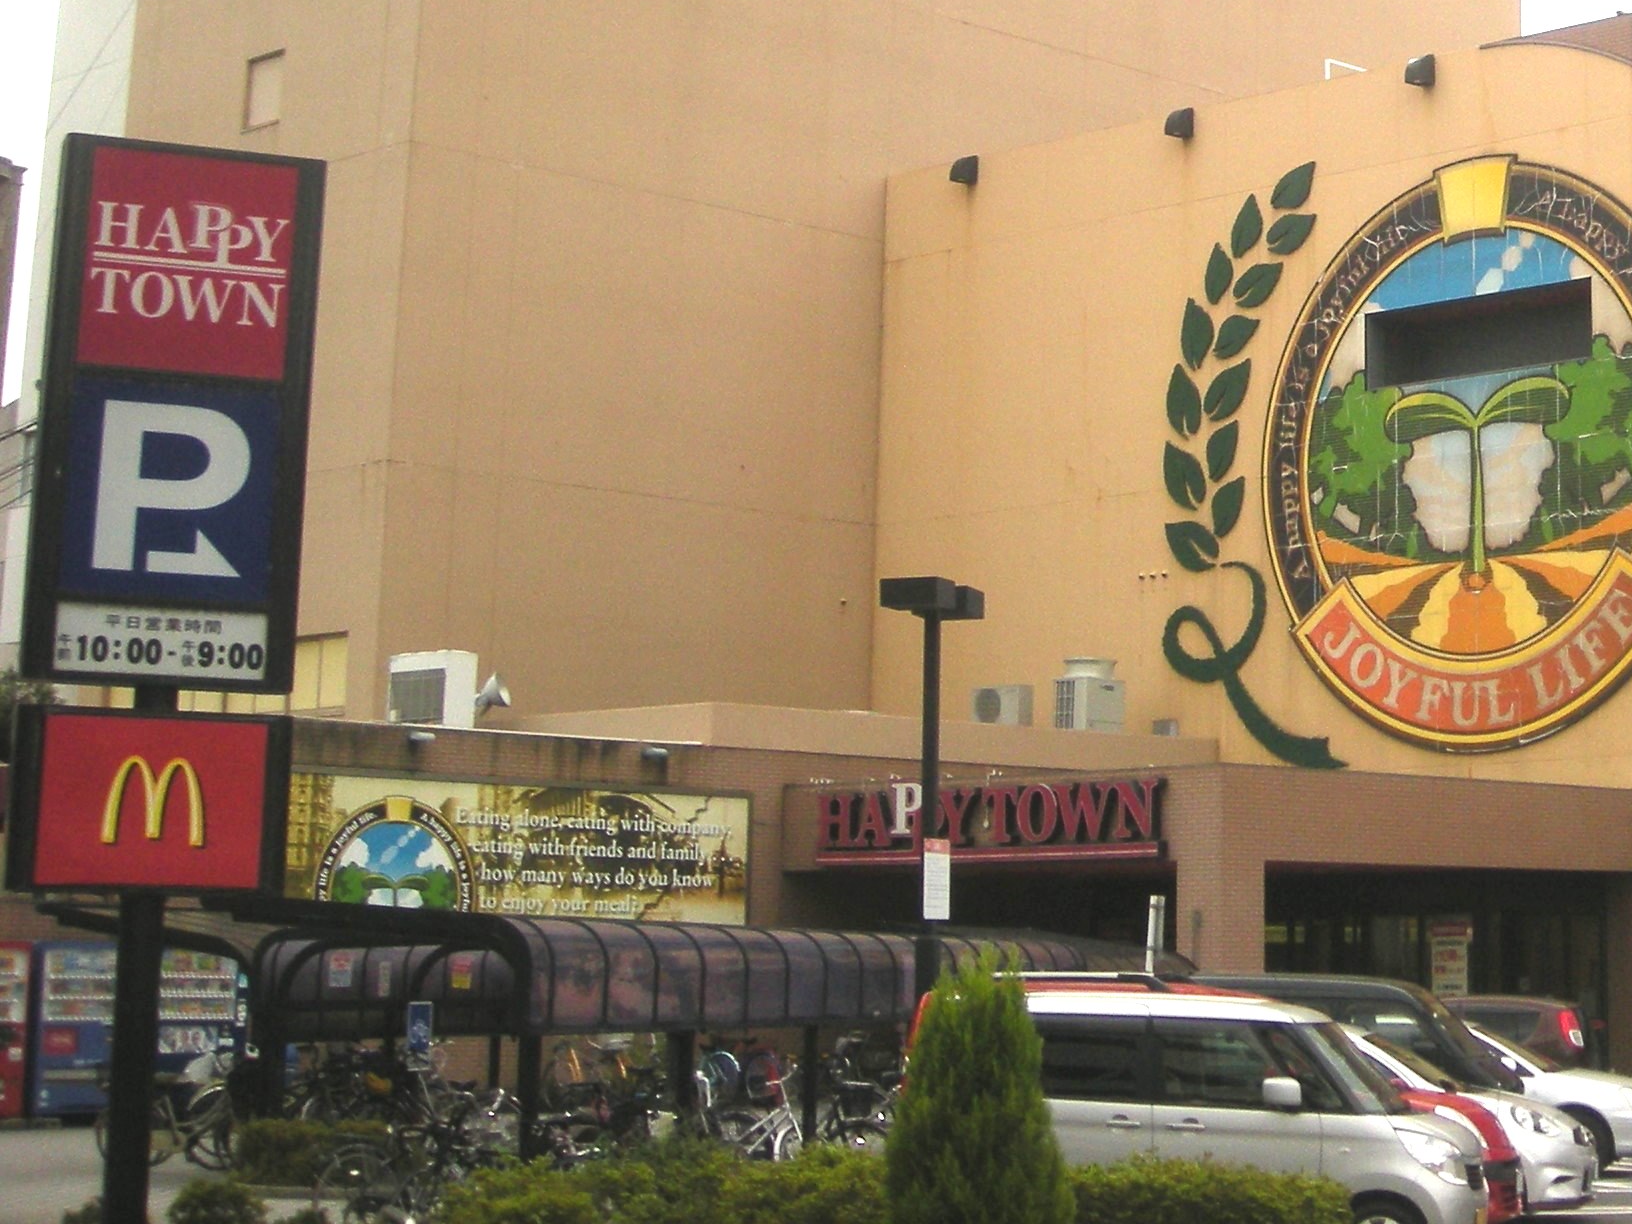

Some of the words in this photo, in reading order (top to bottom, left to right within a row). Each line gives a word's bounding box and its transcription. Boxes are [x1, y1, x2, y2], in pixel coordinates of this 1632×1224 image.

[94, 200, 290, 266] HAPPY
[91, 267, 285, 327] TOWN
[91, 399, 251, 571] P
[106, 614, 222, 634] 平日営業時間
[77, 635, 162, 665] 10:00
[197, 641, 263, 670] 9:00
[1323, 623, 1514, 726] JOYFUL
[455, 807, 510, 831] Eating
[515, 809, 563, 829] alone,
[567, 812, 619, 835] eating
[621, 814, 656, 833] with
[817, 780, 976, 848] HAPY
[982, 780, 1157, 843] TOWN
[472, 836, 524, 866] eating
[528, 837, 564, 855] with
[569, 837, 623, 858] friends
[628, 841, 656, 859] and
[480, 862, 515, 881] how
[521, 869, 566, 888] many
[572, 871, 611, 889] ways
[615, 867, 634, 885] do
[639, 871, 668, 890] you
[672, 869, 712, 888] know
[462, 882, 470, 912] joyfu
[480, 894, 497, 908] to
[502, 897, 543, 914] enjoy
[551, 899, 588, 915] your
